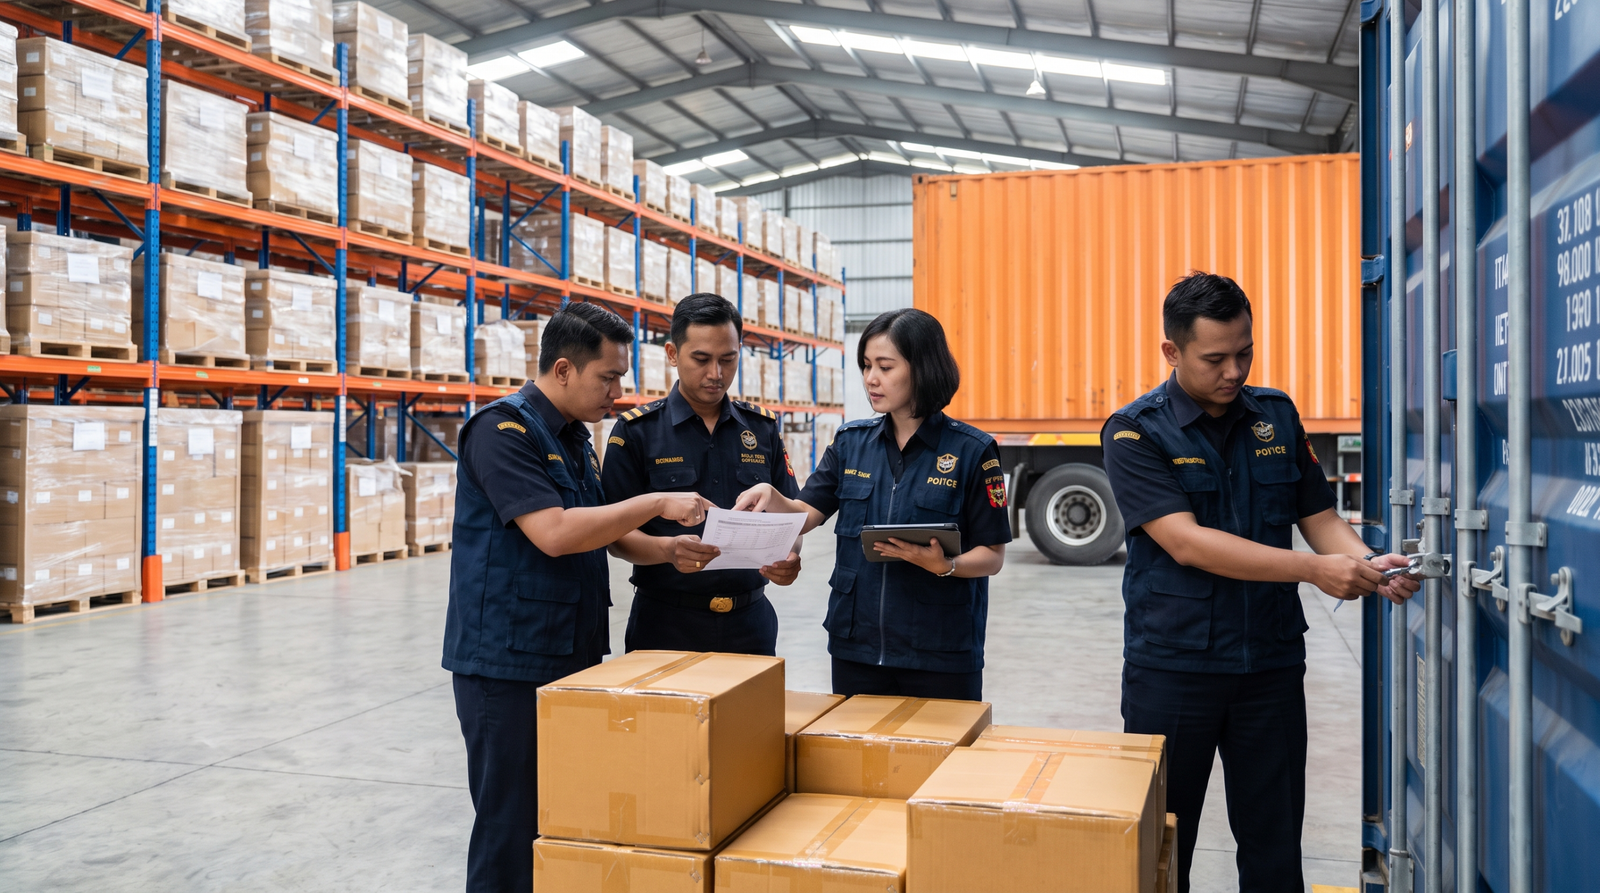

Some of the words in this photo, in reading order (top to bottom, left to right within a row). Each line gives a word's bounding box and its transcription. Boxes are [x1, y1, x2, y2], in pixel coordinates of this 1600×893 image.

[1557, 193, 1592, 245] 37.108
[1557, 241, 1591, 288] 98.000
[1556, 341, 1591, 385] 21.005
